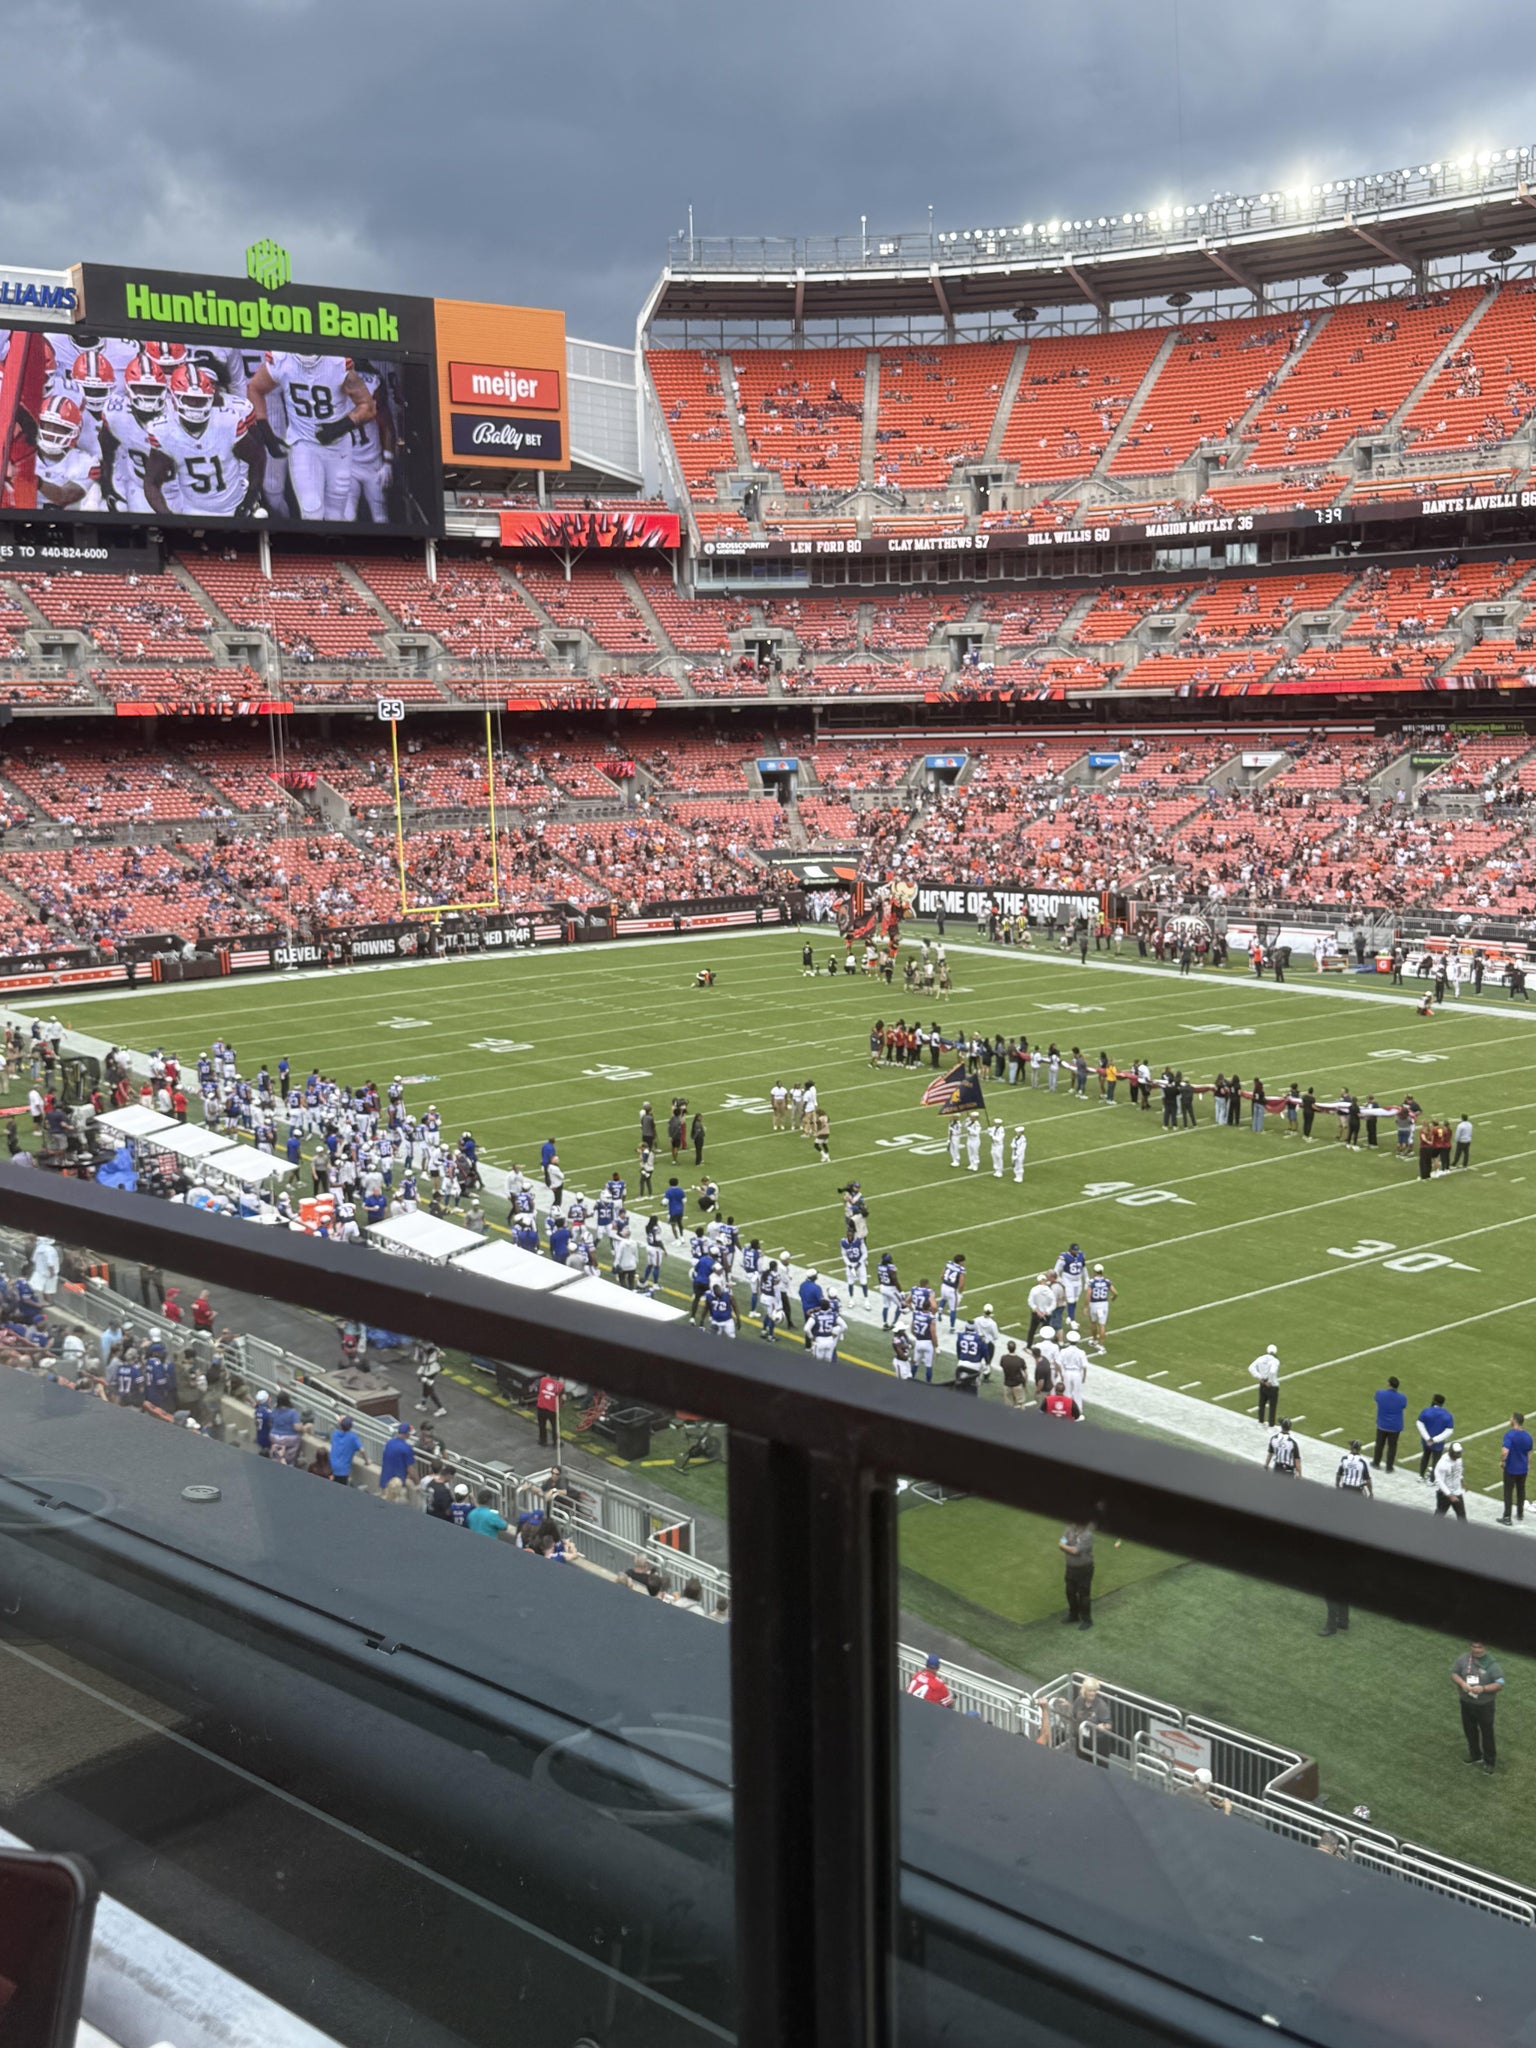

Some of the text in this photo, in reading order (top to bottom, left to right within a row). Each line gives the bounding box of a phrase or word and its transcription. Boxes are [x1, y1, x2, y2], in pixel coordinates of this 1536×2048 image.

[126, 283, 399, 342] Huntington Bank
[472, 370, 538, 403] meijer
[289, 382, 334, 420] 58
[472, 422, 542, 451] Bally BET
[184, 455, 228, 494] 51
[1422, 498, 1464, 514] DANTE
[1465, 493, 1518, 511] LAVELLI
[1145, 515, 1254, 537] MARION MOTLEY 36
[1315, 508, 1342, 524] 7:39
[790, 539, 862, 553] LEN FORD 80
[888, 535, 990, 551] CLAY MATTHEWS 57
[1027, 527, 1111, 546] BILL WILLIS 60
[1, 546, 108, 559] ES TO 440-824-6000
[382, 702, 401, 717] 25
[994, 891, 1024, 916] THE
[582, 1064, 653, 1081] 30
[1081, 1181, 1179, 1206] 40
[1326, 1239, 1454, 1273] 30
[959, 1342, 979, 1356] 93
